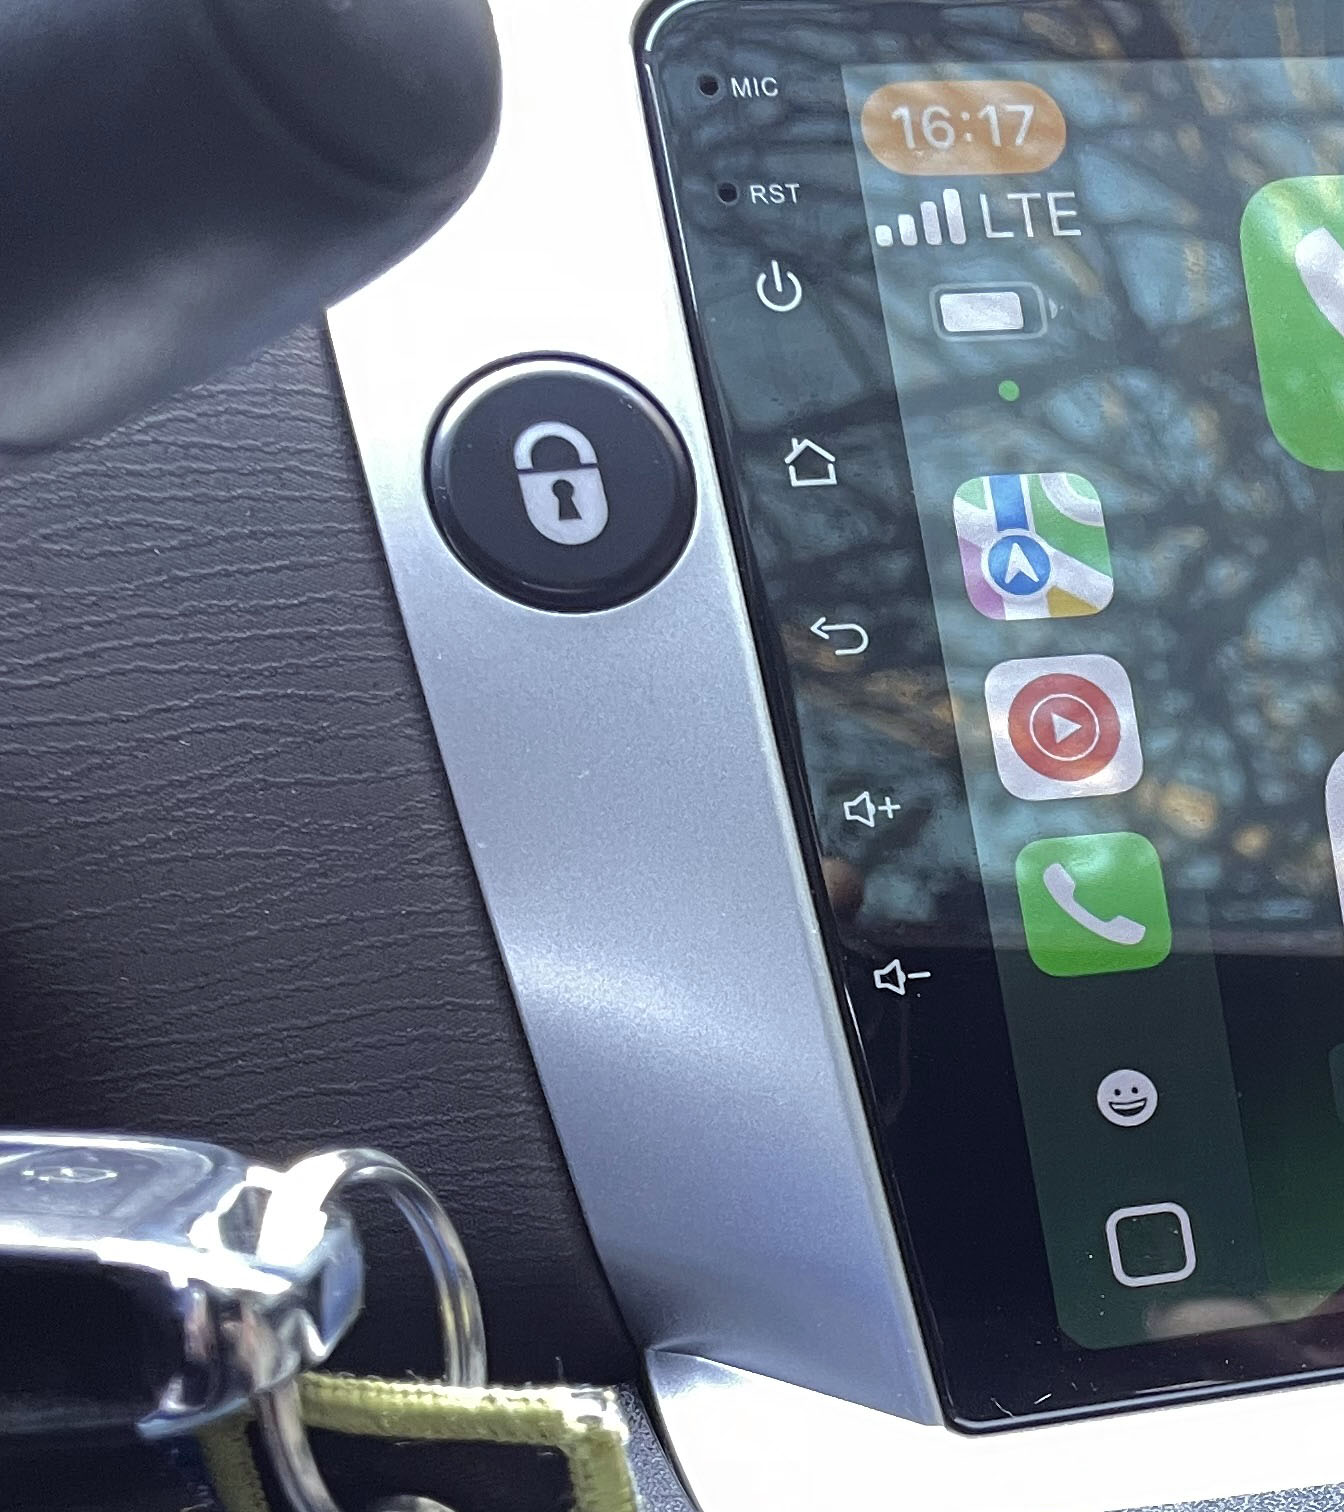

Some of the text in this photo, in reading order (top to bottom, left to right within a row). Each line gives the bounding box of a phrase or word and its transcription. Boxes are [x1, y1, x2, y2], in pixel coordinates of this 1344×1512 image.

[731, 76, 779, 98] MIC
[890, 104, 1036, 151] 16:17
[749, 183, 801, 205] RST
[979, 191, 1082, 238] LTE
